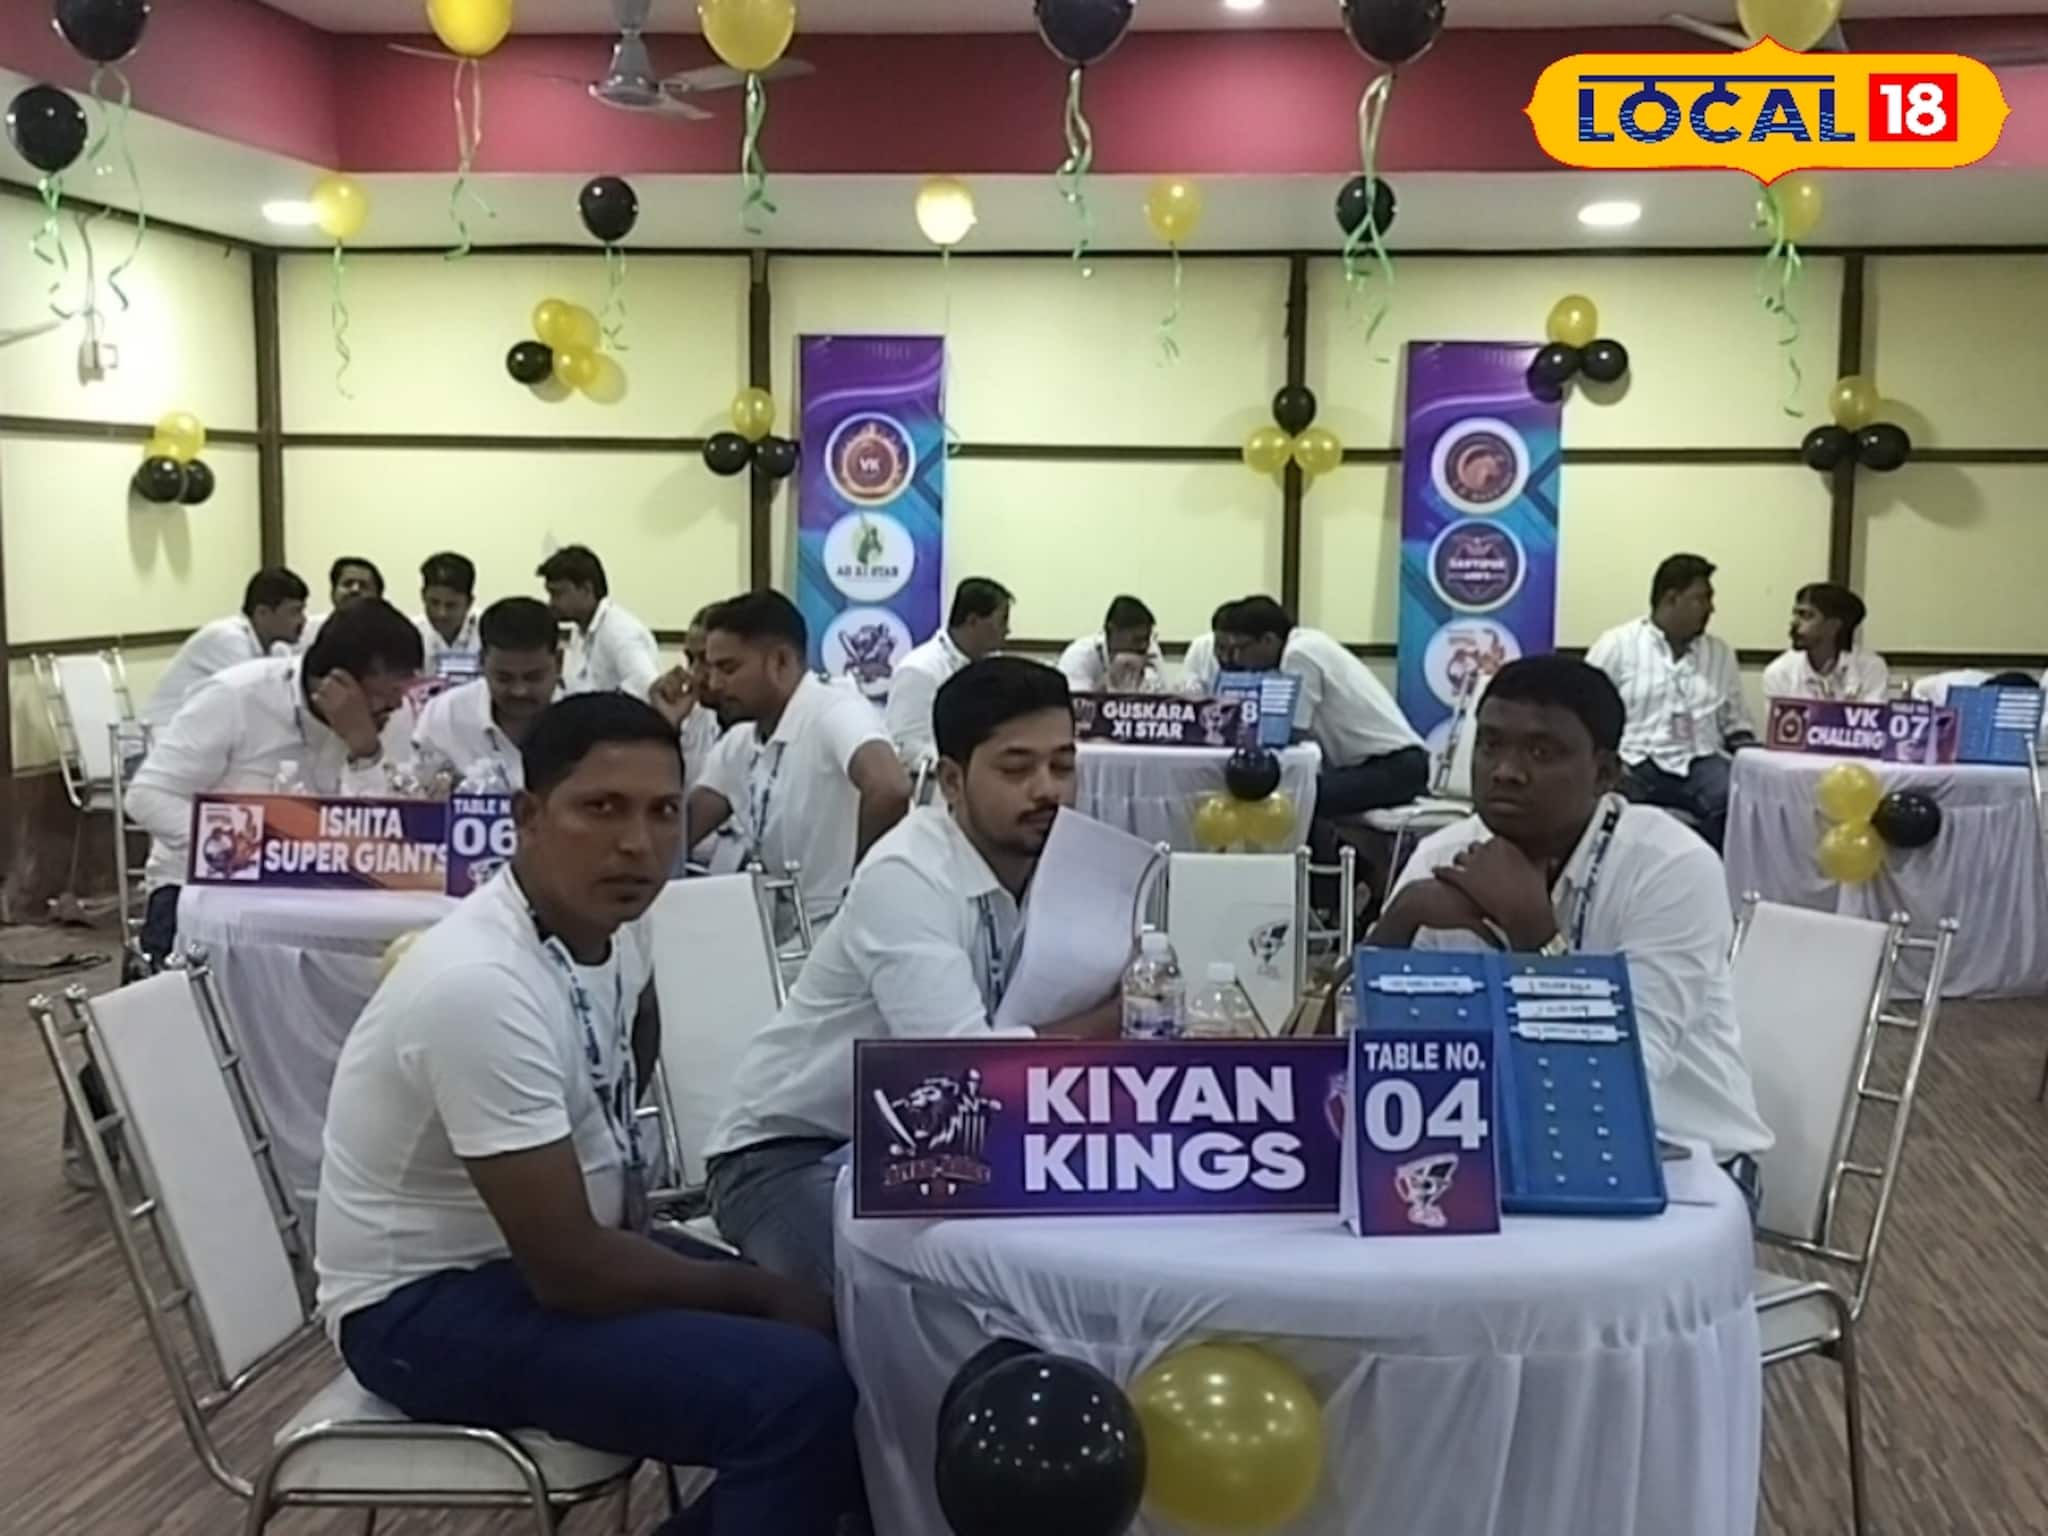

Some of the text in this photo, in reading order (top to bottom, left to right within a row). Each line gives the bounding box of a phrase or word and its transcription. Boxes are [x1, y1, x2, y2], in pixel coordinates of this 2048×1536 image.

[1102, 702, 1196, 722] GUSKARA
[1845, 706, 1879, 729] VK
[1889, 714, 1929, 740] 07
[1112, 721, 1183, 739] XI STAR
[319, 805, 403, 837] ISHITA
[454, 798, 496, 814] TABLE
[452, 817, 516, 856] 06
[265, 840, 348, 872] SUPER
[1363, 1042, 1485, 1071] TABLE NO.
[1027, 1067, 1294, 1123] KIYAN
[1364, 1078, 1488, 1152] 04
[1025, 1132, 1305, 1191] KINGS
